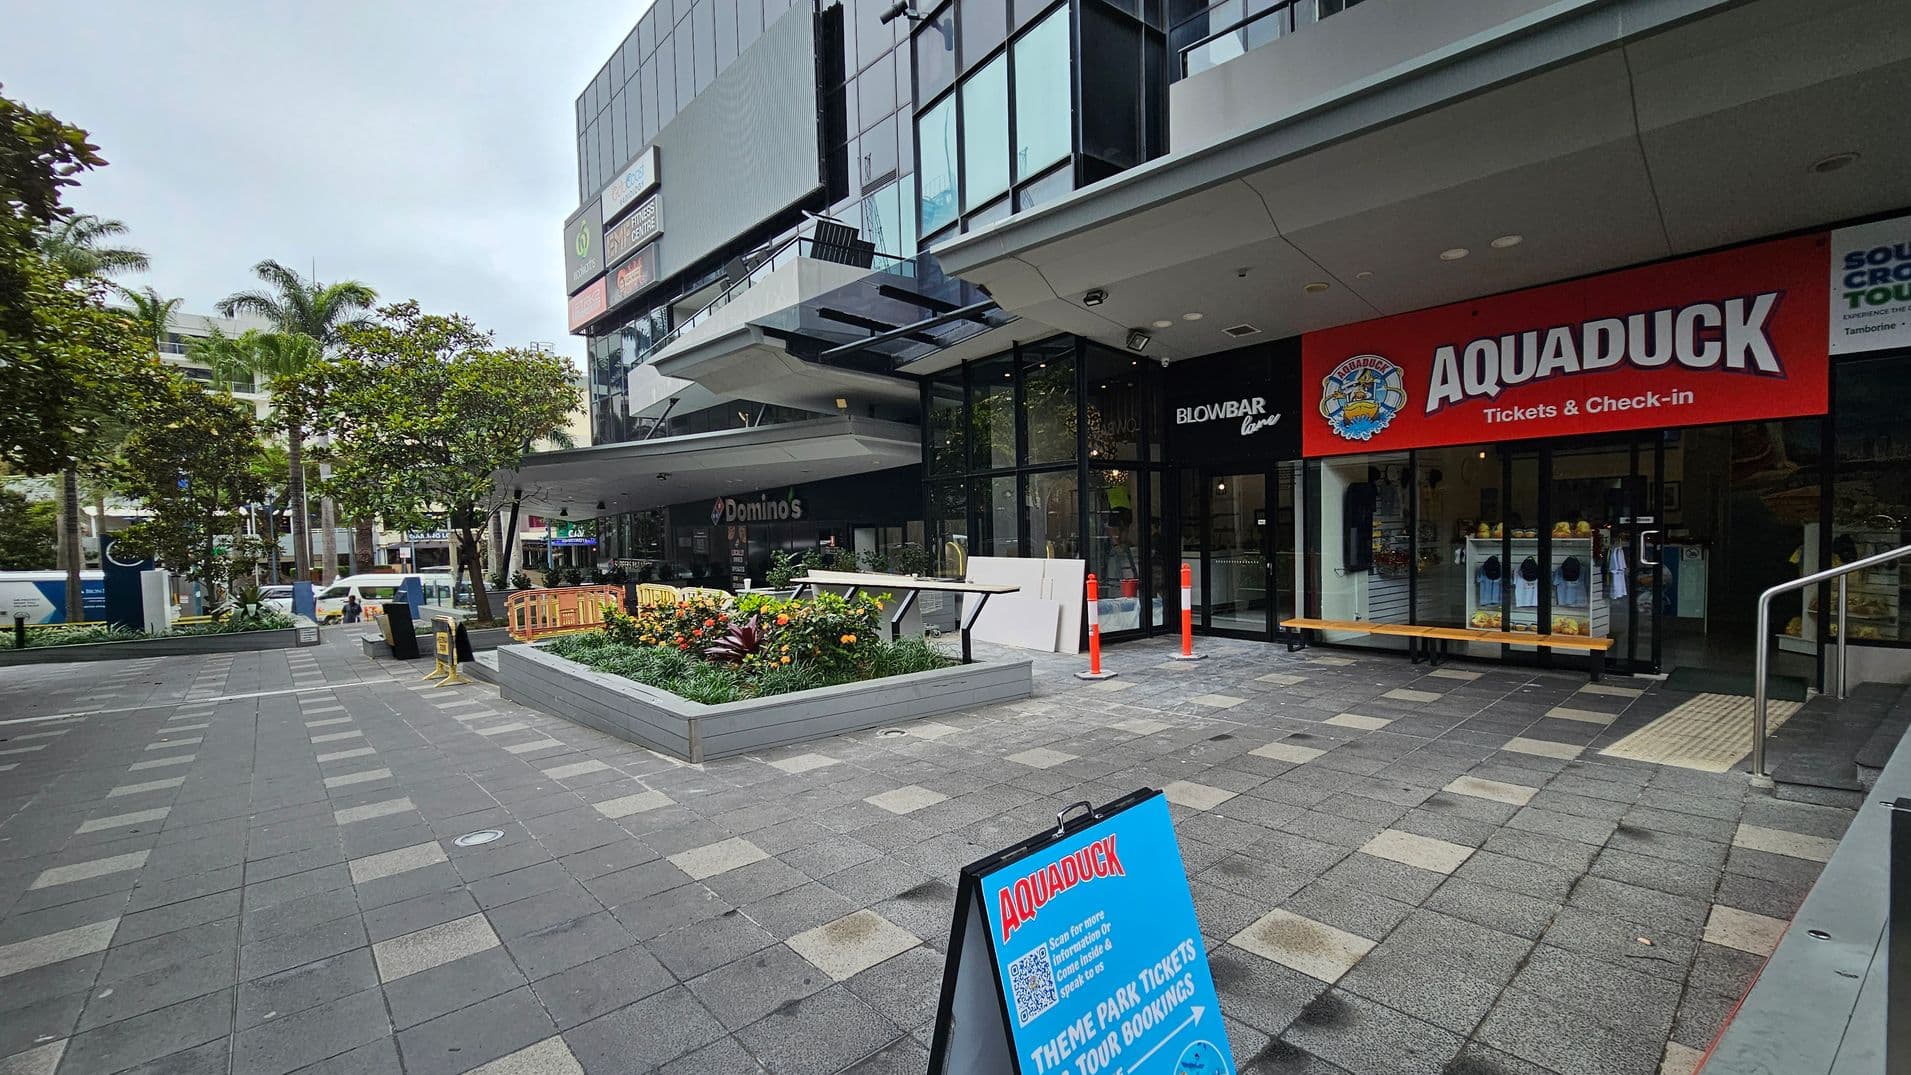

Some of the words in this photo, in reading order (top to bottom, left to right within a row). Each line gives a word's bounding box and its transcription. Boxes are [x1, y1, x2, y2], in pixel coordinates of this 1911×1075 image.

[631, 201, 655, 229] FITNESS
[631, 216, 656, 242] CENTRE
[1844, 242, 1911, 270] SOU
[1843, 262, 1911, 289] CRO
[1843, 283, 1911, 309] TOU
[1843, 308, 1889, 320] EXPERIENCE
[1891, 305, 1906, 314] THE
[1844, 322, 1897, 336] Tamborine
[1424, 289, 1786, 416] AQUADUCK
[1337, 358, 1390, 379] AQUADUCK
[1176, 397, 1266, 424] BLOWBAR
[1483, 403, 1557, 424] Tickets
[1563, 399, 1580, 416] &
[1585, 388, 1694, 414] Check-in
[1241, 413, 1281, 436] lane
[725, 489, 802, 522] Domino's
[998, 833, 1126, 945] AQUADUCK
[1049, 932, 1070, 950] Scan
[1070, 922, 1083, 937] for
[1084, 910, 1104, 929] more
[1052, 929, 1101, 966] information
[1057, 960, 1080, 981] Come
[1080, 944, 1103, 966] inside
[1104, 938, 1112, 951] &
[1060, 974, 1085, 998] speak
[1085, 968, 1094, 980] to
[1095, 961, 1105, 974] us
[1031, 1011, 1097, 1075] THEME
[1096, 981, 1141, 1030] PARK
[1138, 938, 1196, 994] TICKETS
[1075, 1031, 1122, 1075] TOUR
[1121, 972, 1195, 1046] BOOKINGS
